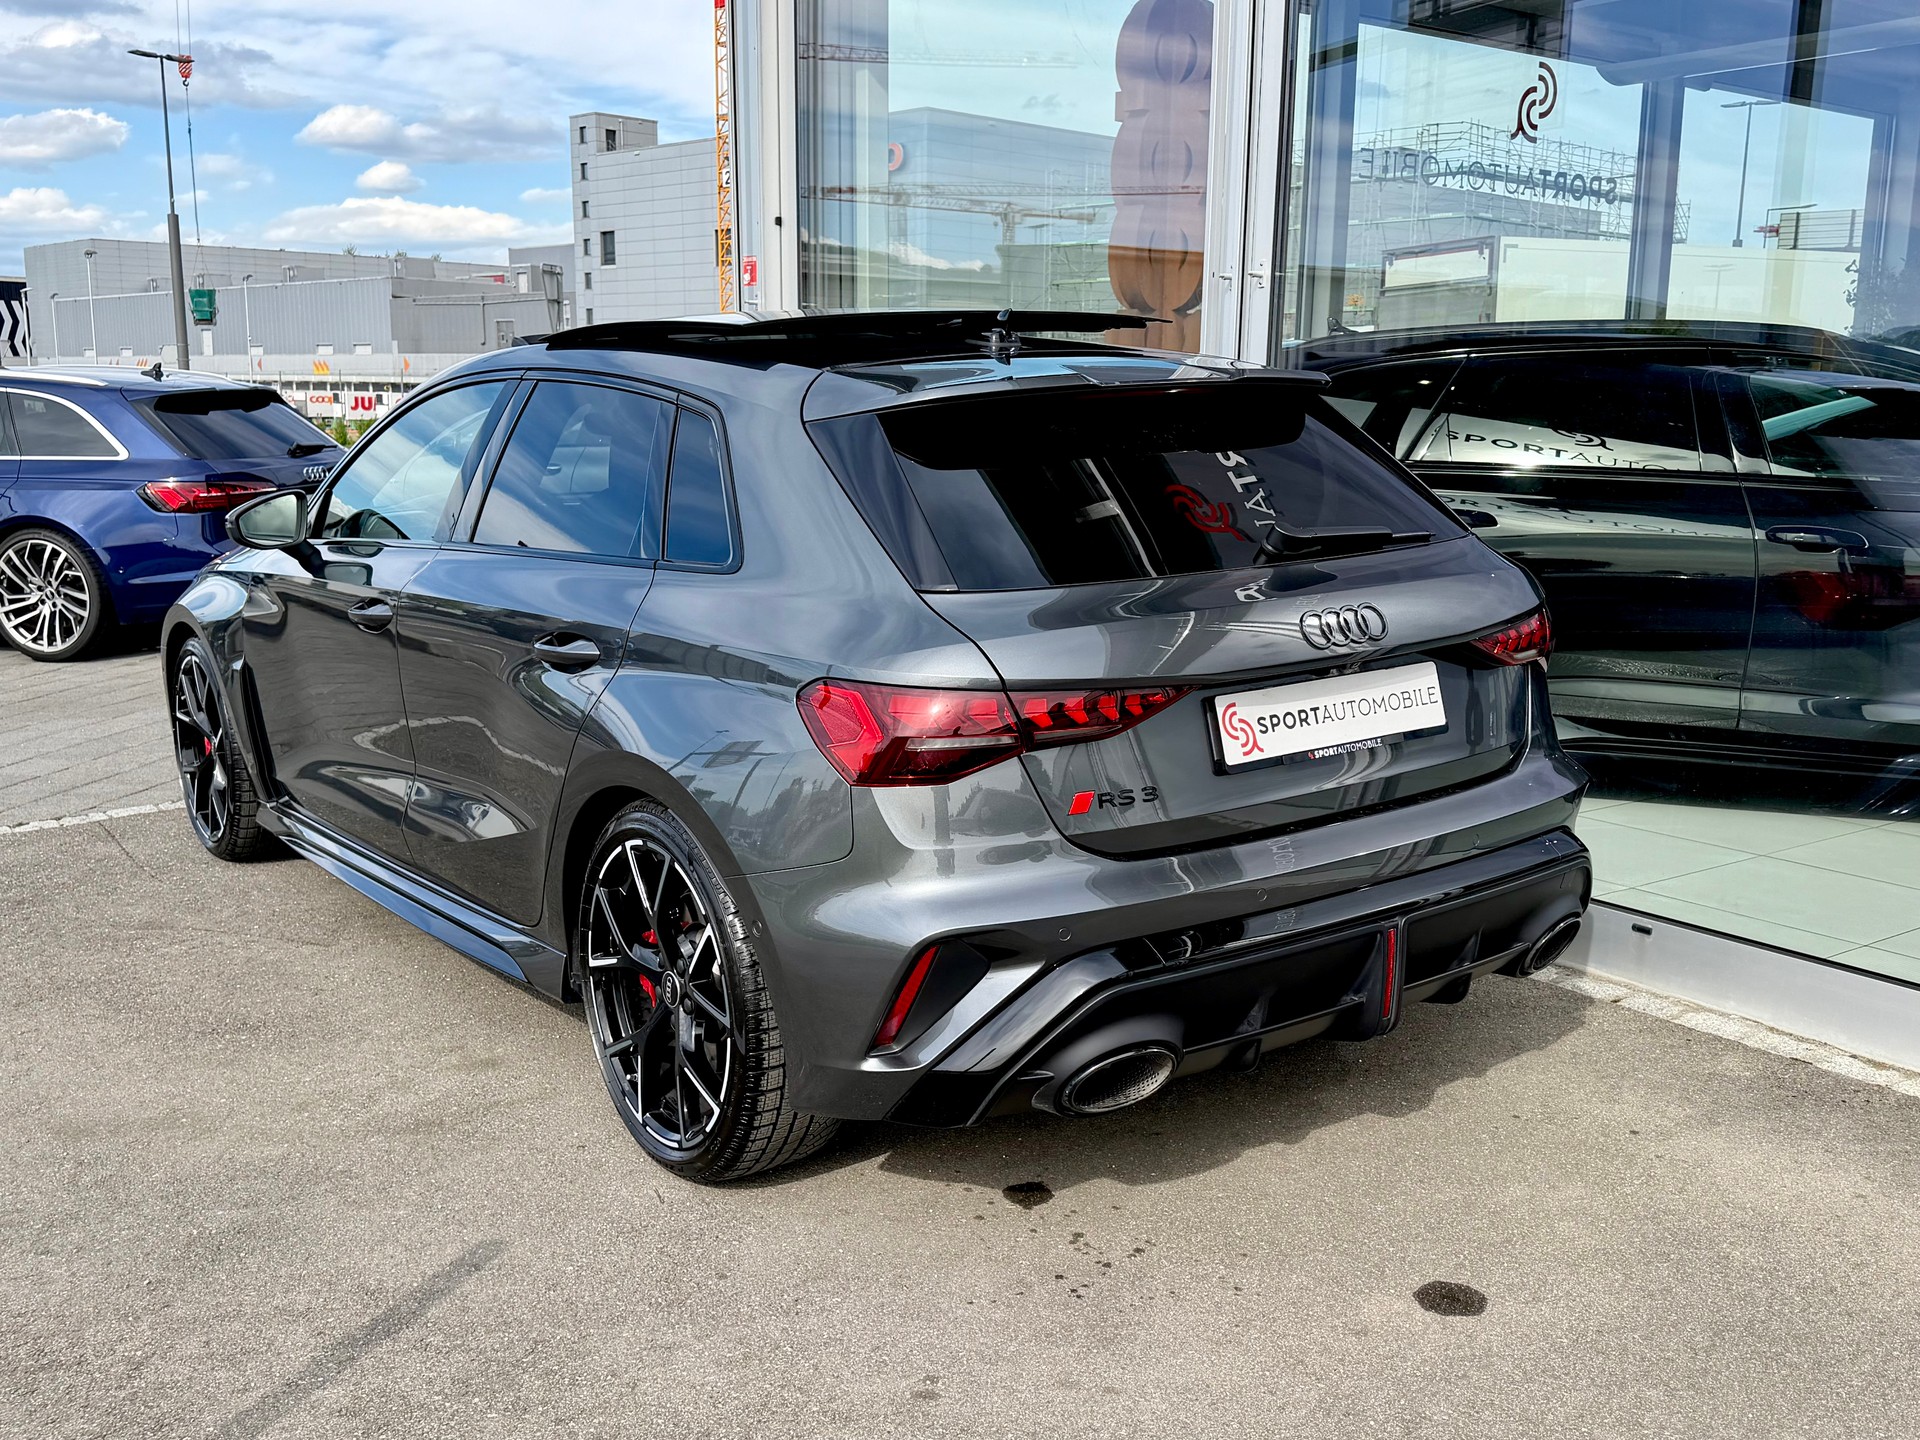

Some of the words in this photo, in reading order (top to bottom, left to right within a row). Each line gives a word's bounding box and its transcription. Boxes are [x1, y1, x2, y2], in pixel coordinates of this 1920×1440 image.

[1256, 686, 1439, 734] SPORTAUTOMOBILE
[1314, 737, 1383, 759] SPORTAUTOMOBILE
[1097, 788, 1136, 810] RS
[1141, 785, 1159, 803] 3
